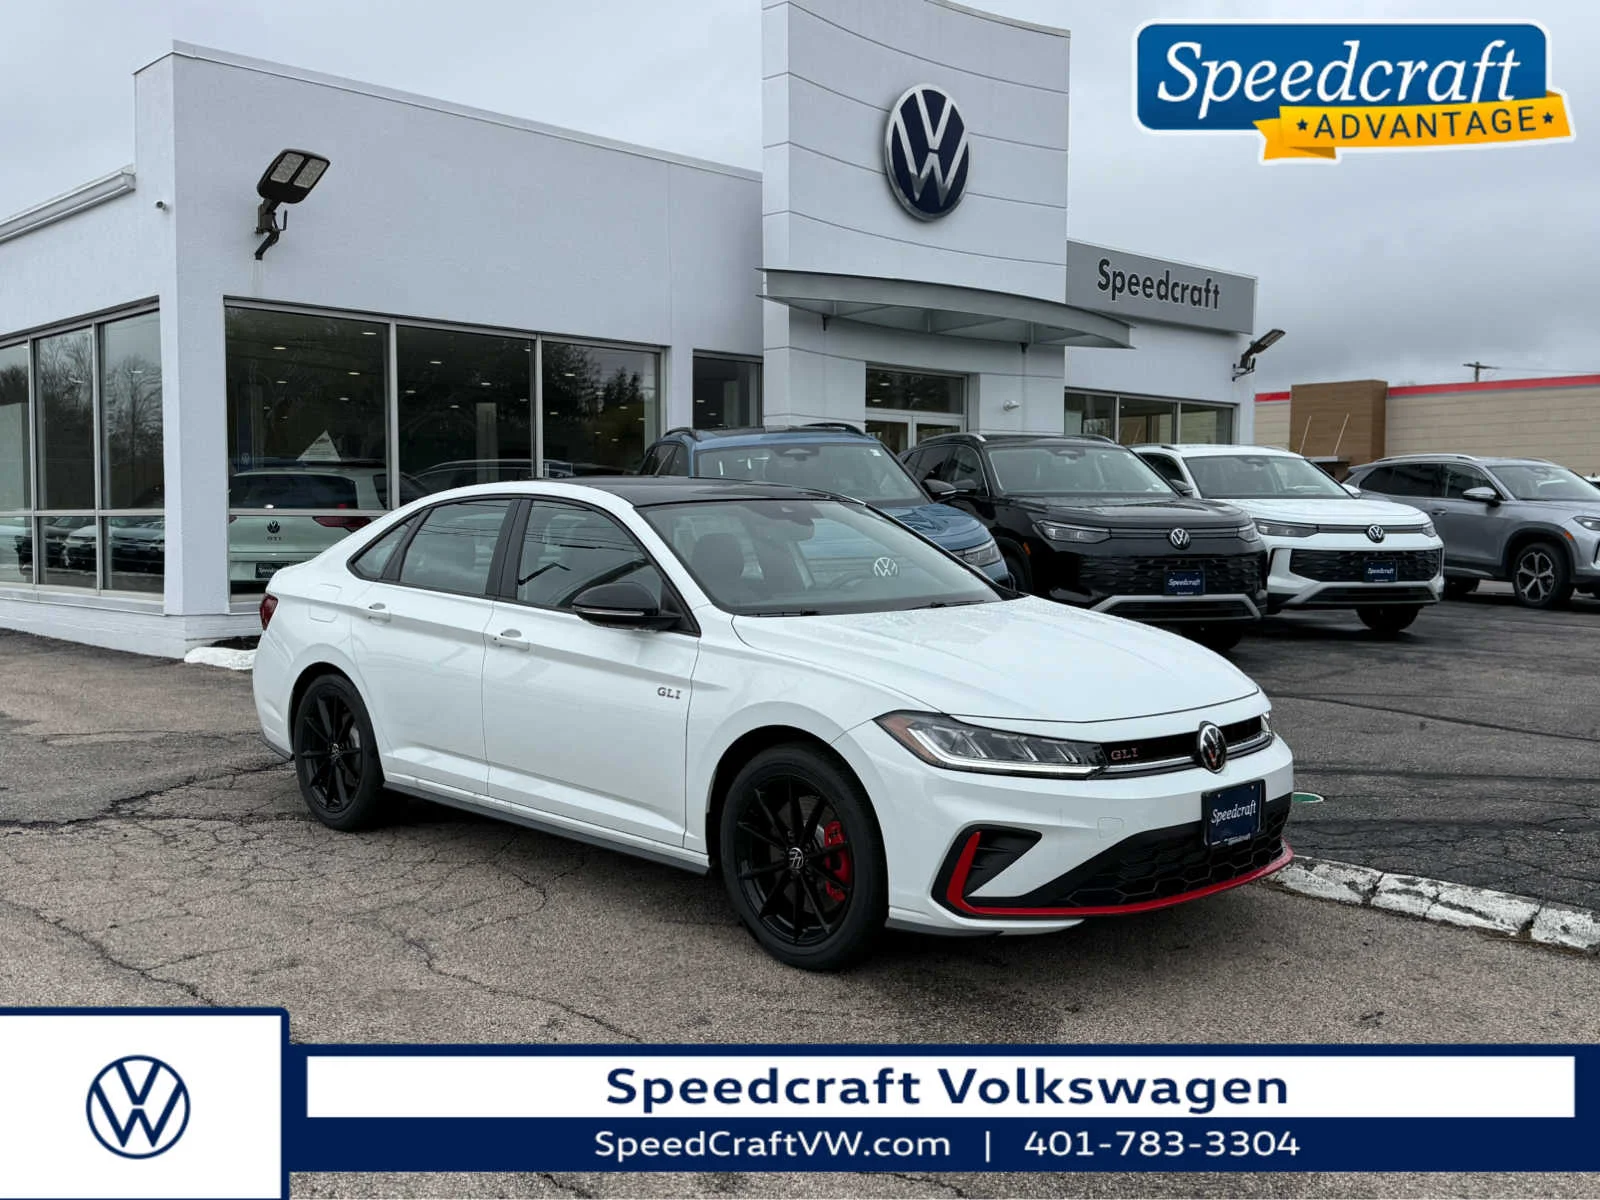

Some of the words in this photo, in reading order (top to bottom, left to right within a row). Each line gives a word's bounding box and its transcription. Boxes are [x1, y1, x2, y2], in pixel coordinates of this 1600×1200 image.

[1097, 258, 1220, 309] Speedcraft
[657, 686, 681, 700] GLI
[1110, 747, 1140, 761] GLI
[1210, 799, 1257, 827] Speedcraft
